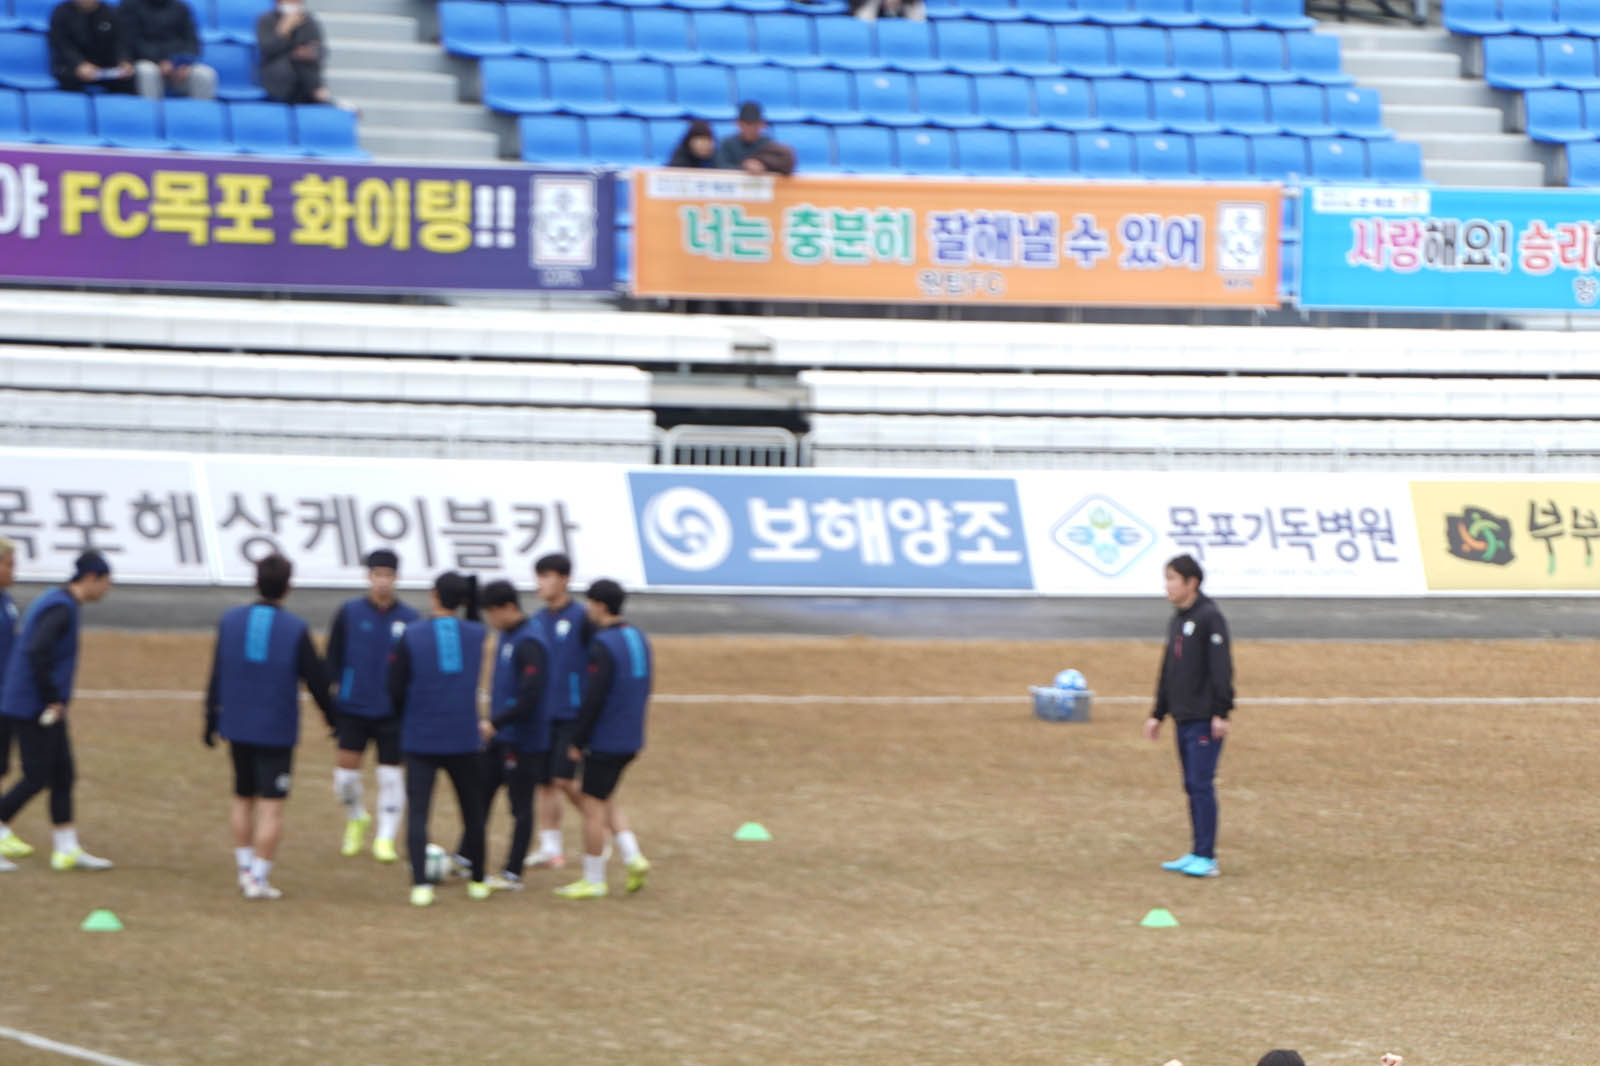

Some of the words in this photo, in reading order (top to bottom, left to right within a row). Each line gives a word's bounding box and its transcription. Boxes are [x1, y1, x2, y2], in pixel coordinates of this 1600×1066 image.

[60, 169, 276, 246] FC목포
[290, 173, 517, 253] 화이팅!!
[684, 206, 768, 259] 너는
[787, 206, 913, 264] 충분히
[1068, 216, 1107, 263] 수
[1121, 217, 1201, 266] 있어
[1349, 219, 1509, 271] 사랑해요!
[745, 496, 1024, 568] 보해양조
[1166, 505, 1399, 564] 목포기독병원
